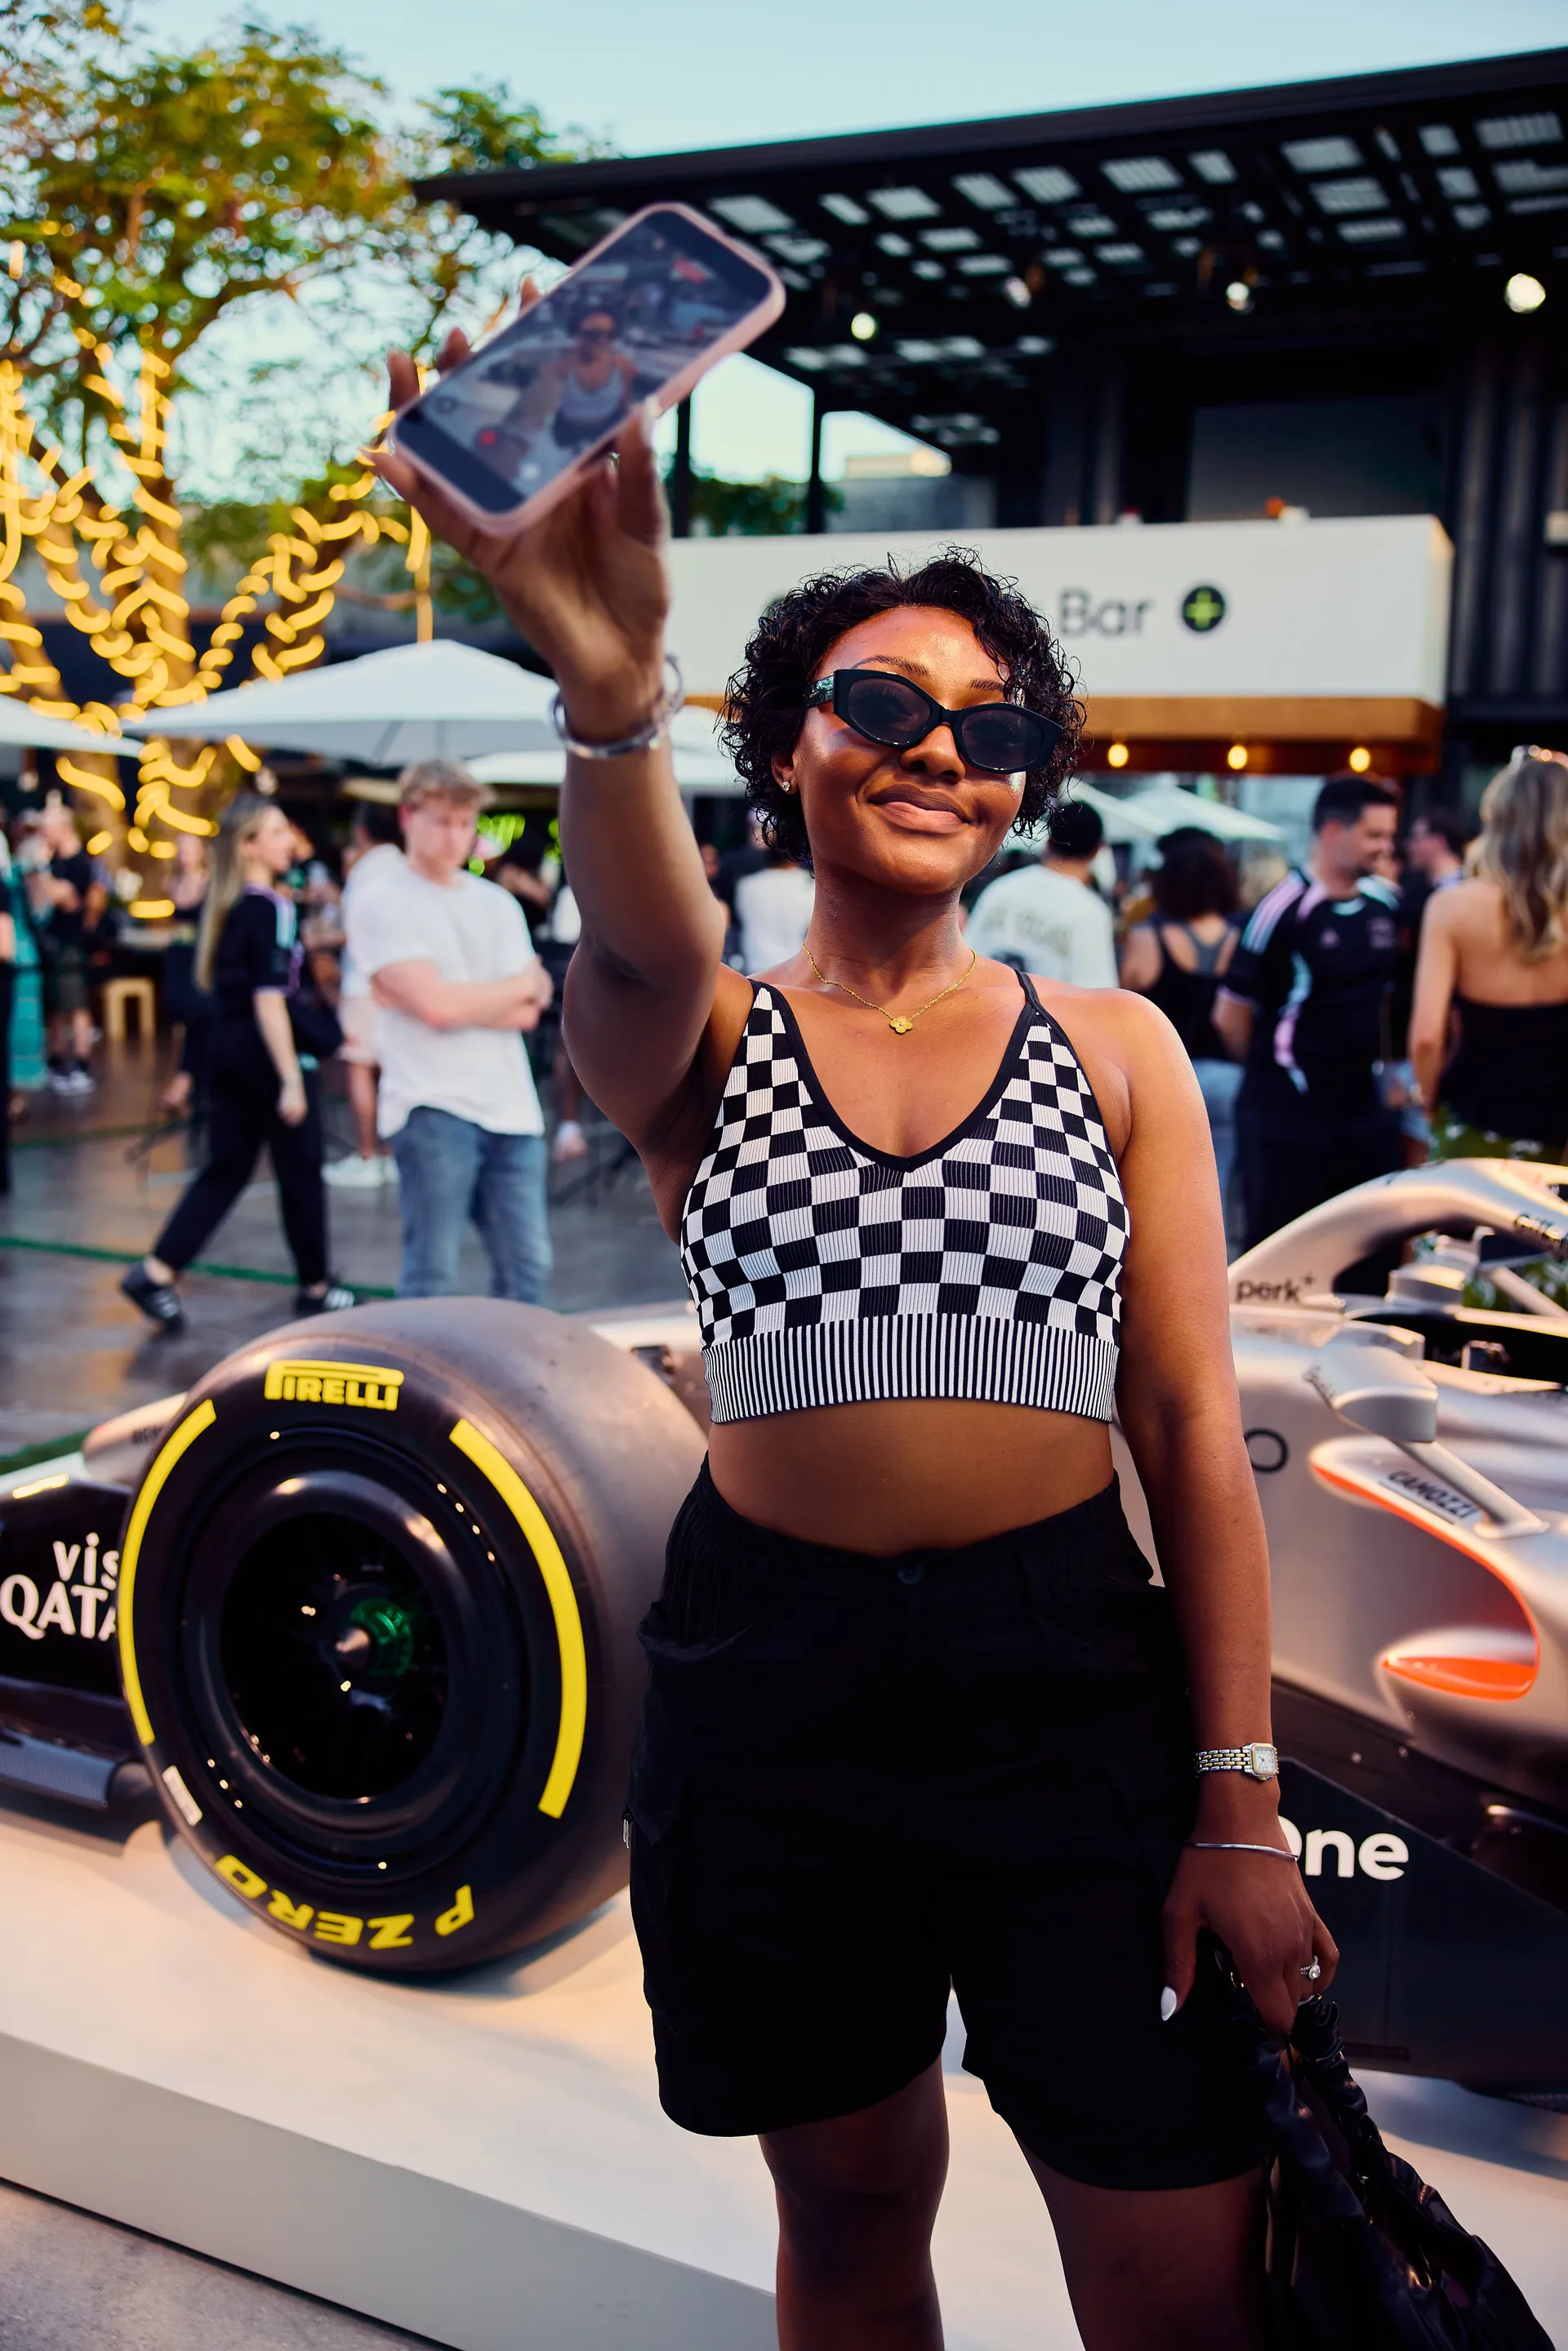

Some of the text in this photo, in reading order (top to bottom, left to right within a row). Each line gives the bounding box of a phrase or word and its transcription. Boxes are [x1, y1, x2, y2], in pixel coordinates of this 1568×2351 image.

[1059, 587, 1152, 637] Bar
[265, 1360, 404, 1411] PIRELLI
[215, 1855, 474, 1950] P ZERO
